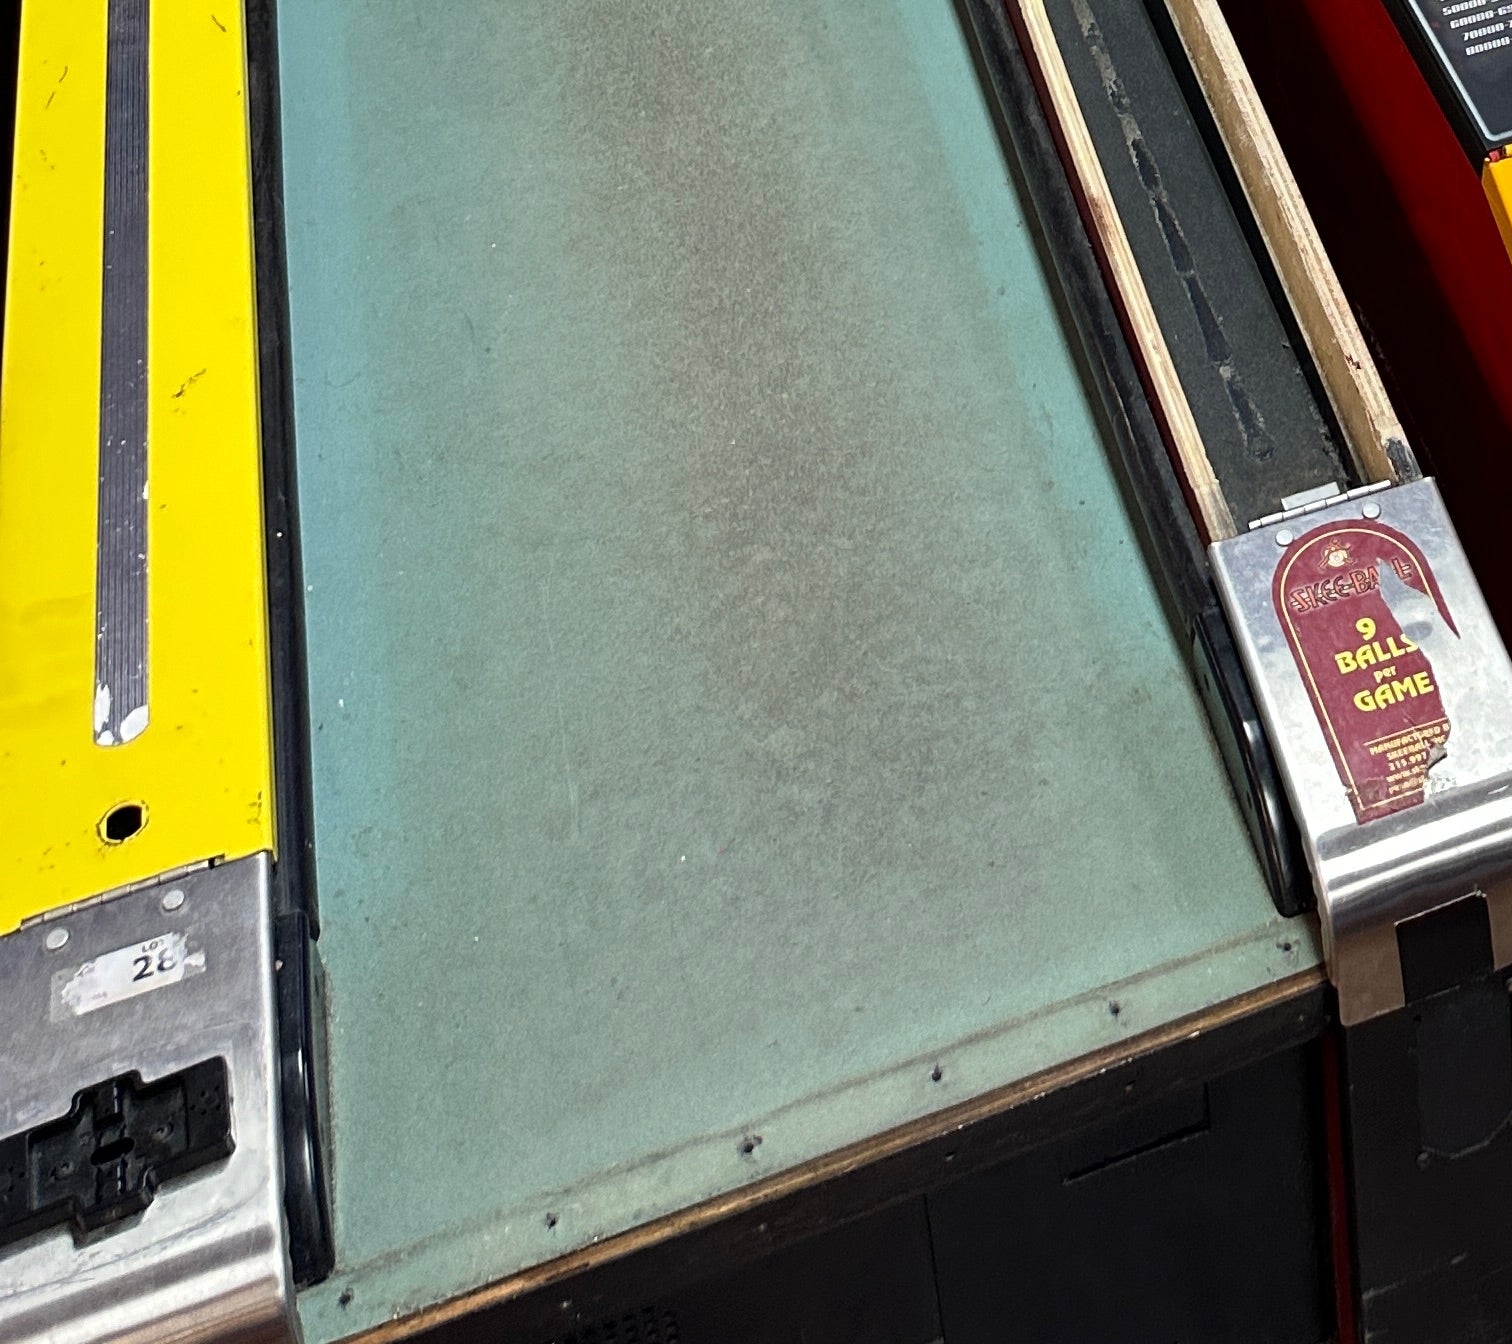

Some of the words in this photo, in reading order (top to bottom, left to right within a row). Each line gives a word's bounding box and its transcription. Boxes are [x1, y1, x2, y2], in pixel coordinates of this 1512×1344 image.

[1355, 617, 1377, 641] 9
[1334, 633, 1419, 675] BALLS
[1373, 665, 1397, 684] per
[1353, 671, 1435, 712] GAME
